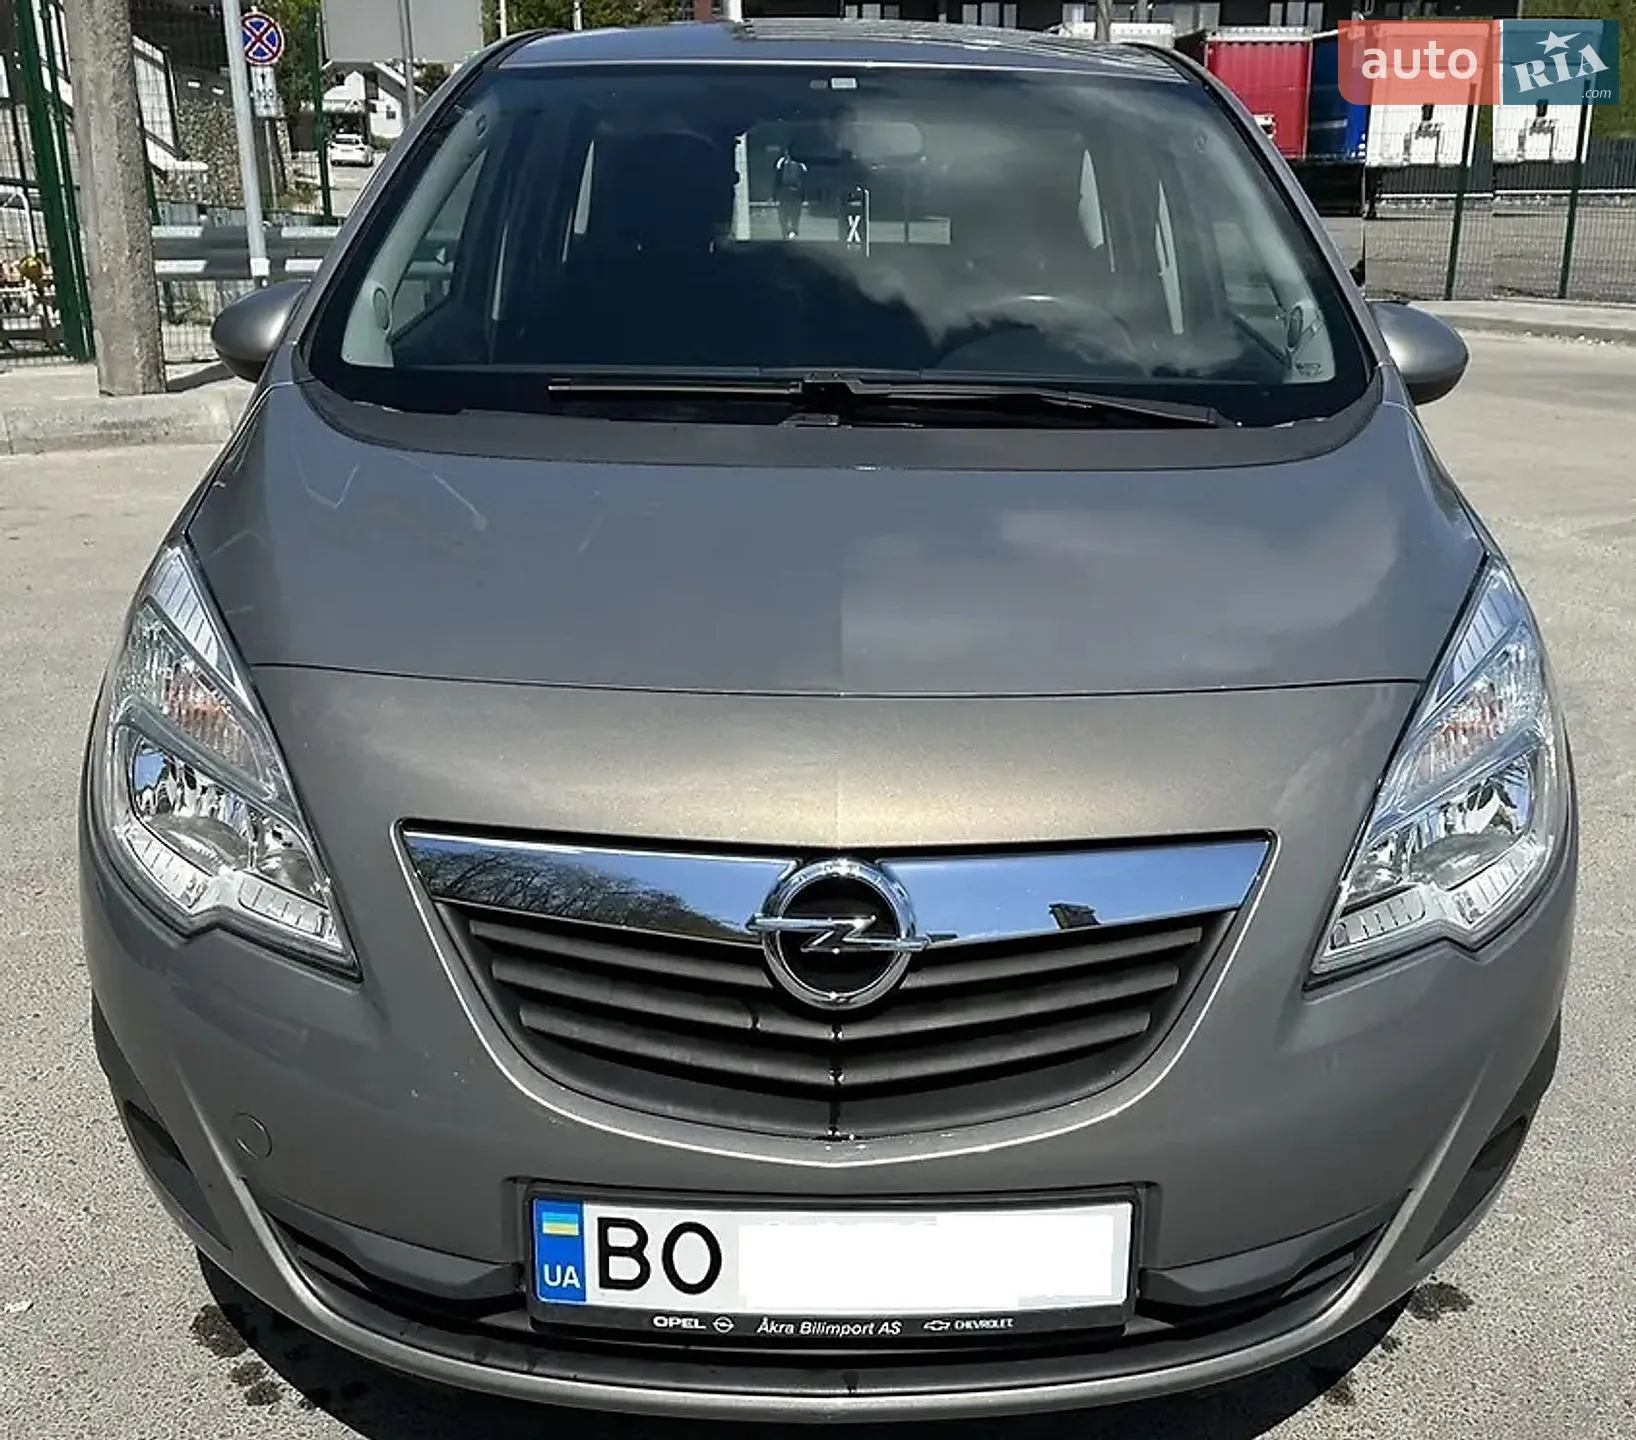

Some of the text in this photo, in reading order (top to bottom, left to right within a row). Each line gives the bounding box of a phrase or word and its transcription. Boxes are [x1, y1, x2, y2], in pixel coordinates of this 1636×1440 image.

[597, 1216, 722, 1295] BO
[543, 1264, 580, 1288] UA
[652, 1315, 706, 1330] OPEL
[756, 1316, 903, 1336] Åkra Bilimport AS
